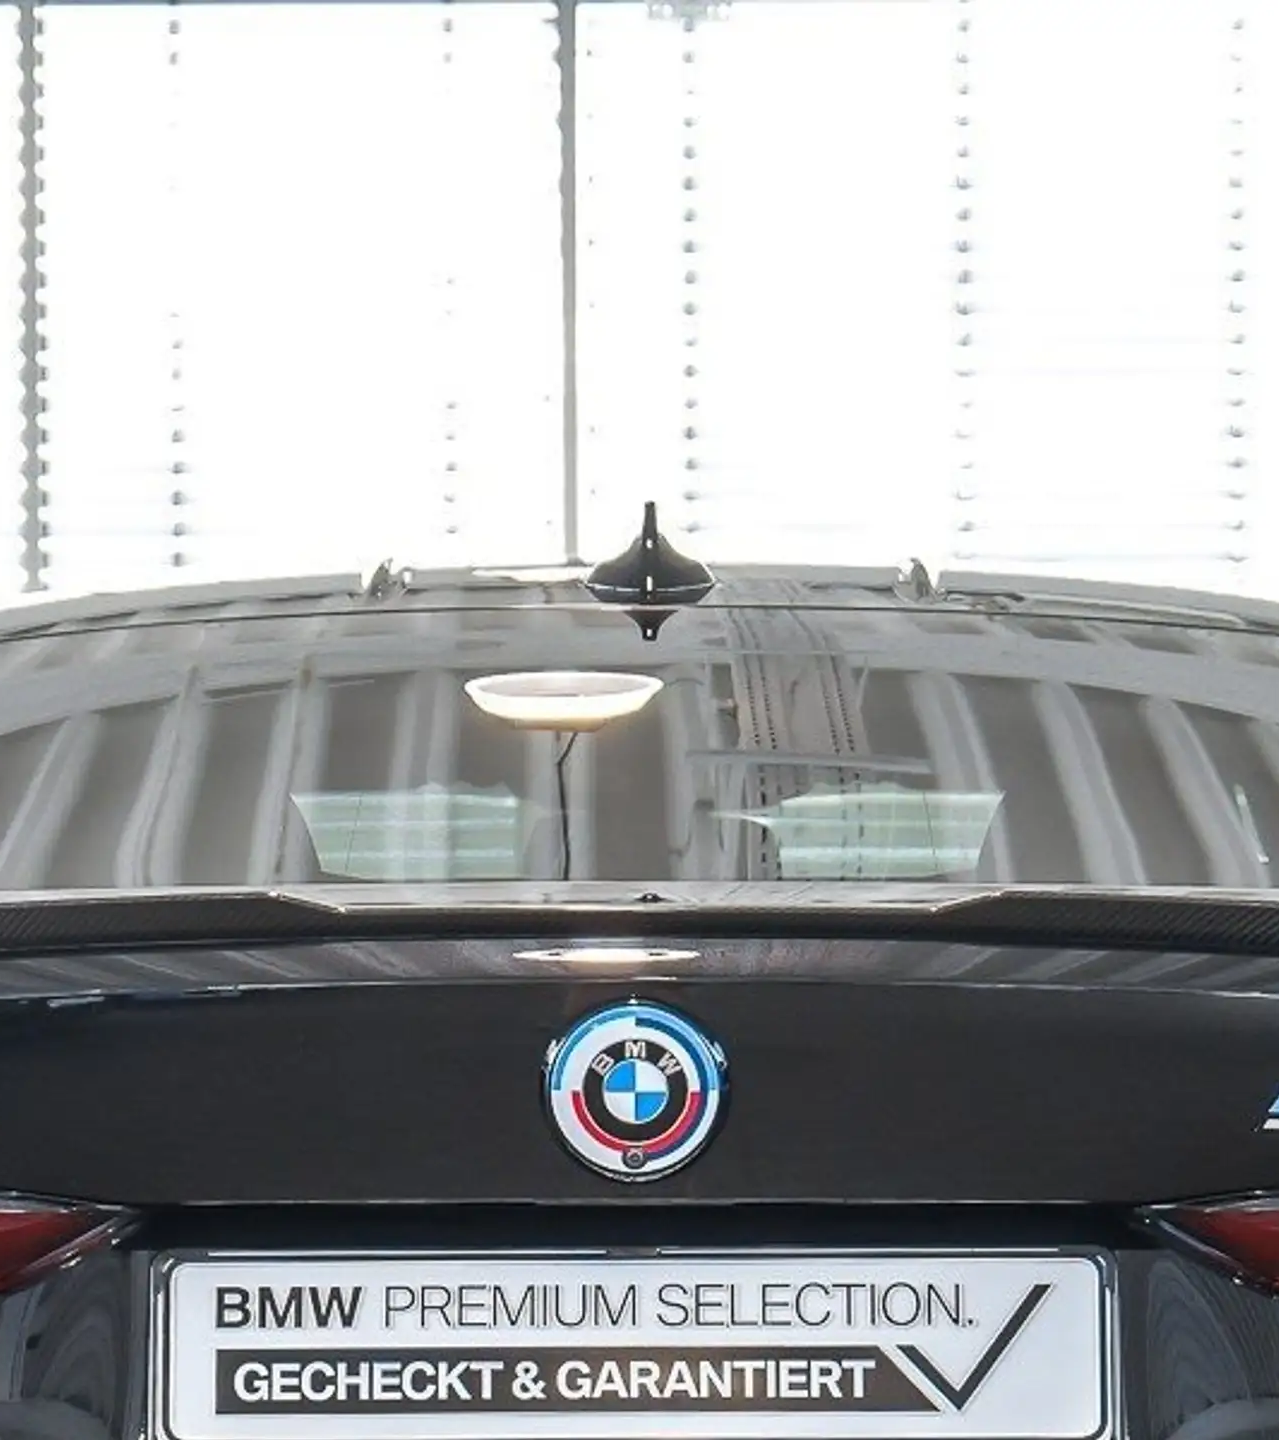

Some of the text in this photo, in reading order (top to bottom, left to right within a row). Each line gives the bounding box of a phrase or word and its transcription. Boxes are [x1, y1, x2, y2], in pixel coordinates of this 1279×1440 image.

[590, 1040, 683, 1076] BMW
[215, 1285, 363, 1329] BMW
[384, 1283, 637, 1329] PREMIUM
[233, 1359, 877, 1402] GECHECKT & GARANTIERT
